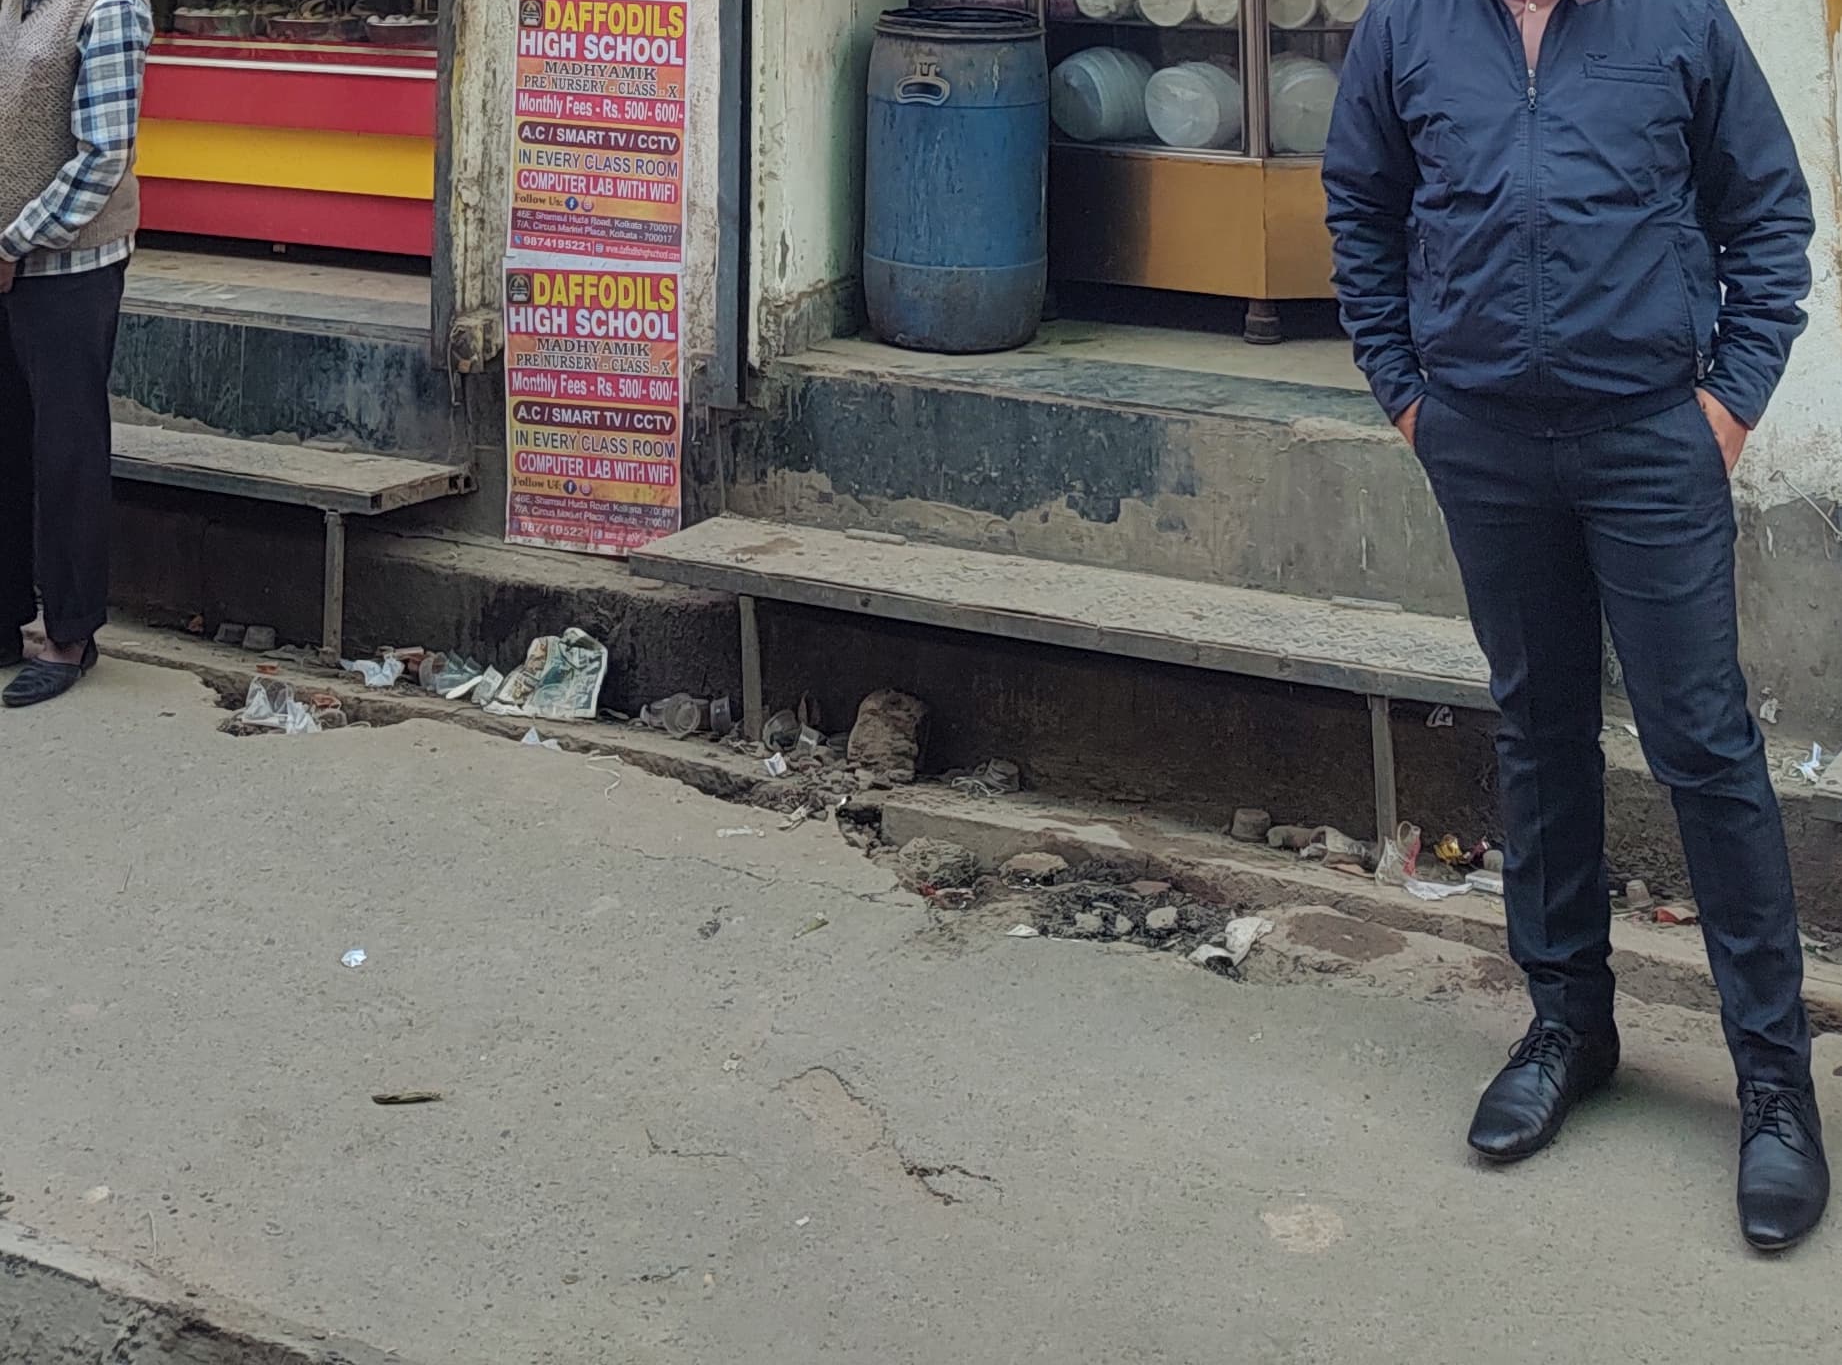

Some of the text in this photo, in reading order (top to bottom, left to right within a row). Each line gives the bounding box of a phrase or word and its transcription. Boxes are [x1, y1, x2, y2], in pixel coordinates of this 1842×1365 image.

[544, 0, 685, 38] DAFFODILS
[519, 29, 684, 66] HIGH SCHOOL
[544, 60, 657, 80] MADHYAMIK
[524, 75, 546, 88] PRE
[550, 76, 606, 93] NURSERY
[618, 82, 657, 96] CLASS
[668, 85, 678, 98] X
[518, 92, 563, 118] Monthly
[566, 95, 593, 116] Fees
[602, 99, 621, 118] Rs.
[624, 100, 653, 120] 500/-
[655, 102, 684, 122] 600/-
[521, 127, 546, 141] A.C
[556, 128, 606, 145] SMART
[609, 133, 627, 146] TV
[637, 135, 677, 151] CCTV
[518, 148, 678, 178] IN EVERY CLASS ROOM
[514, 192, 546, 205] Follow
[520, 170, 675, 202] COMPUTER LAB WITH WIFI
[609, 228, 638, 240] Kolkata
[614, 218, 643, 230] Kolkata
[649, 222, 678, 234] 700017
[523, 235, 592, 252] 9874195221
[533, 272, 676, 312] DAFFODILS
[508, 307, 676, 341] HIGH SCHOOL
[536, 338, 650, 357] MADHYAMIK
[516, 353, 540, 366] PRE
[543, 354, 600, 371] NURSERY
[611, 359, 650, 374] CLASS
[660, 361, 671, 375] X
[511, 371, 557, 397] Monthly
[560, 374, 587, 395] Fees
[597, 377, 616, 397] Rs.
[618, 378, 647, 399] 500/-
[649, 380, 678, 400] 600/-
[516, 404, 542, 420] A.C
[551, 407, 601, 425] SMART
[604, 412, 622, 427] TV
[633, 414, 673, 431] CCTV
[515, 429, 676, 459] IN EVERY CLASS ROOM
[511, 475, 544, 488] Follow
[518, 452, 674, 485] COMPUTER LAB WITH WIFI
